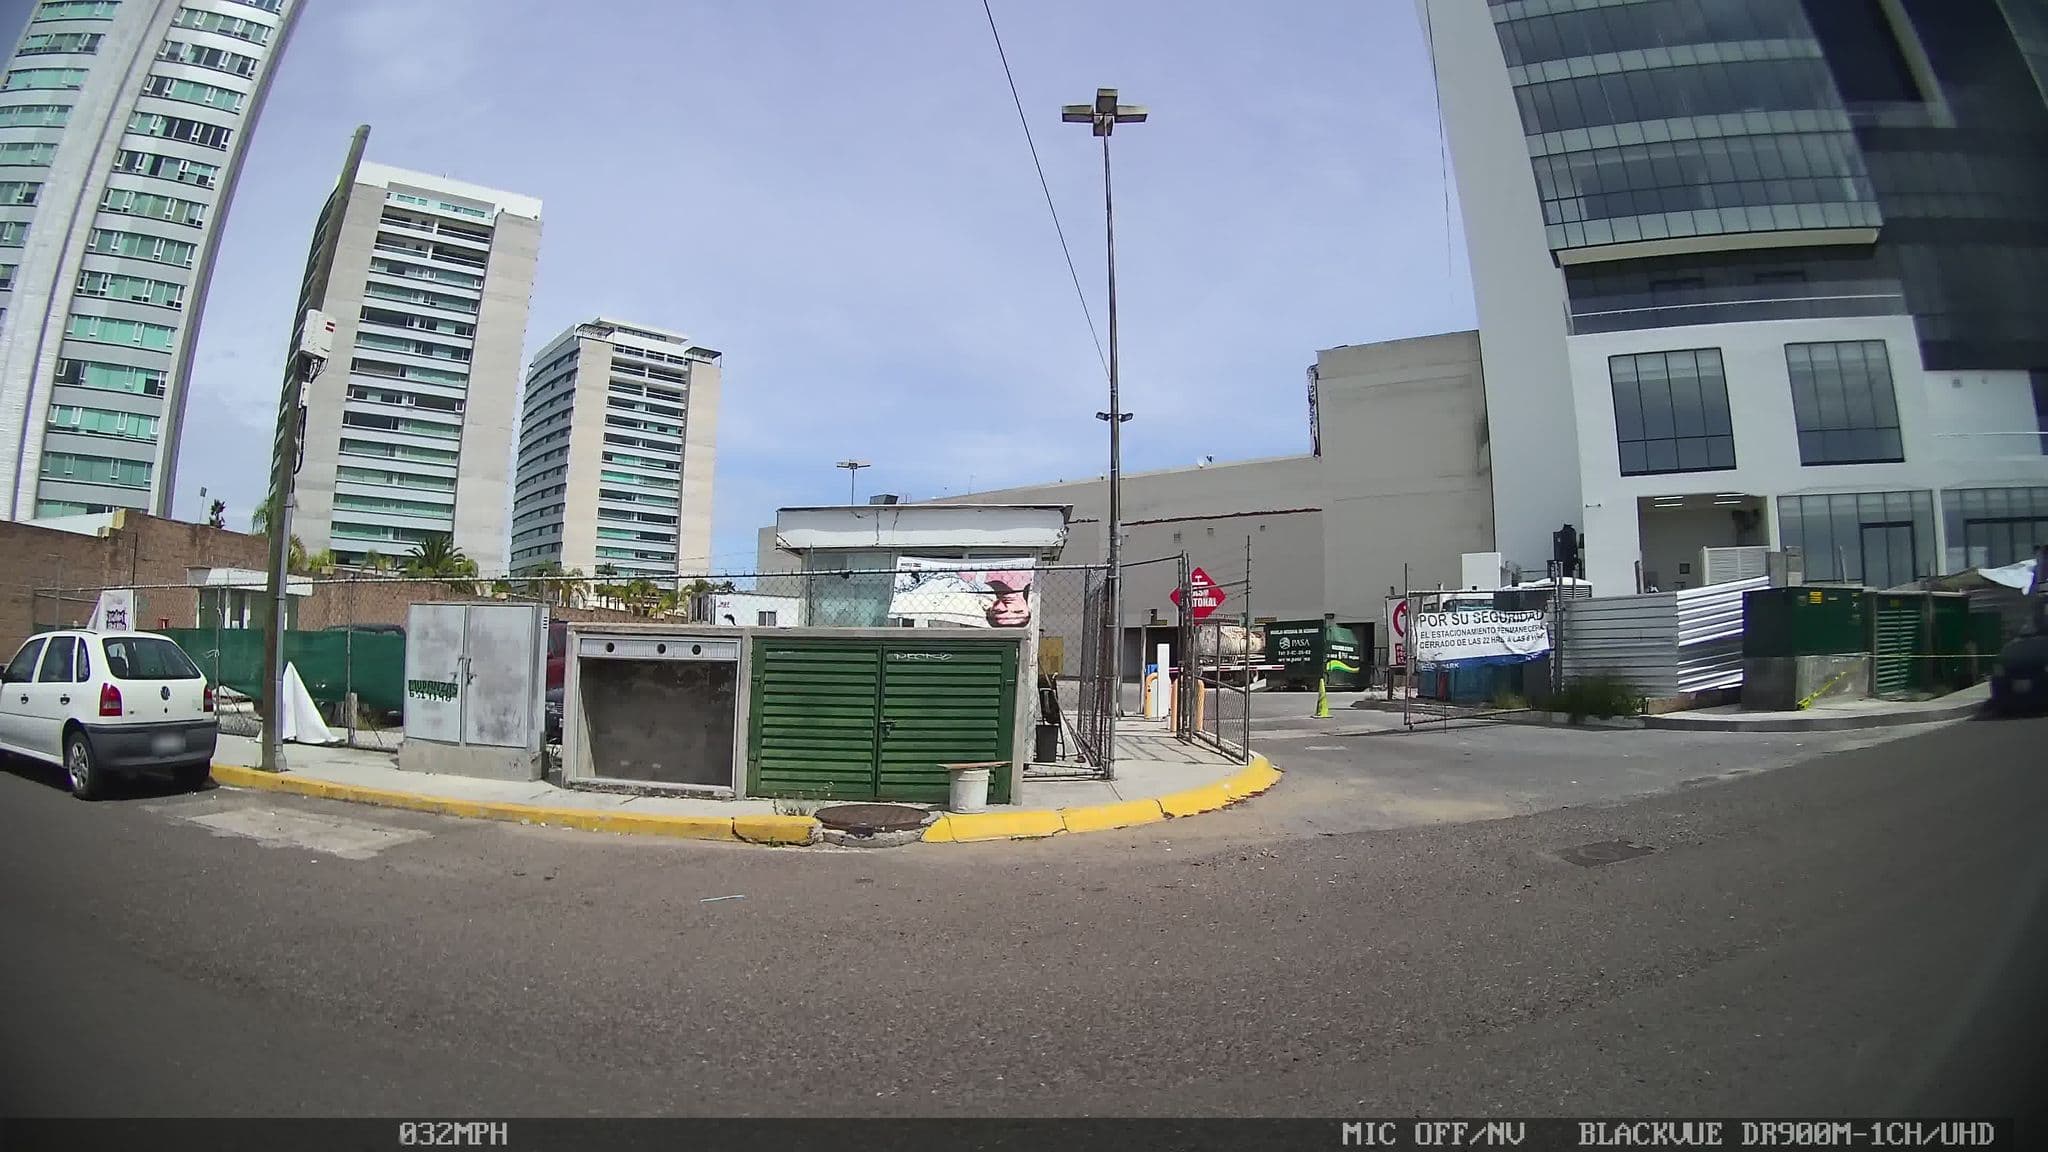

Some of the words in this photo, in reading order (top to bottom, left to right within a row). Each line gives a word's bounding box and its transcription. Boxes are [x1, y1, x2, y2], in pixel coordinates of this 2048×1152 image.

[1419, 614, 1448, 628] POR
[1452, 613, 1469, 625] SU
[1473, 610, 1544, 624] SEGURIDAD
[1420, 631, 1430, 639] EL
[1432, 626, 1496, 639] ESTACIONAMIENTO
[1291, 638, 1310, 647] PASA
[1419, 641, 1456, 649] CERRADO
[1457, 639, 1467, 647] DE
[1468, 638, 1481, 646] LAS
[1482, 637, 1490, 645] 22
